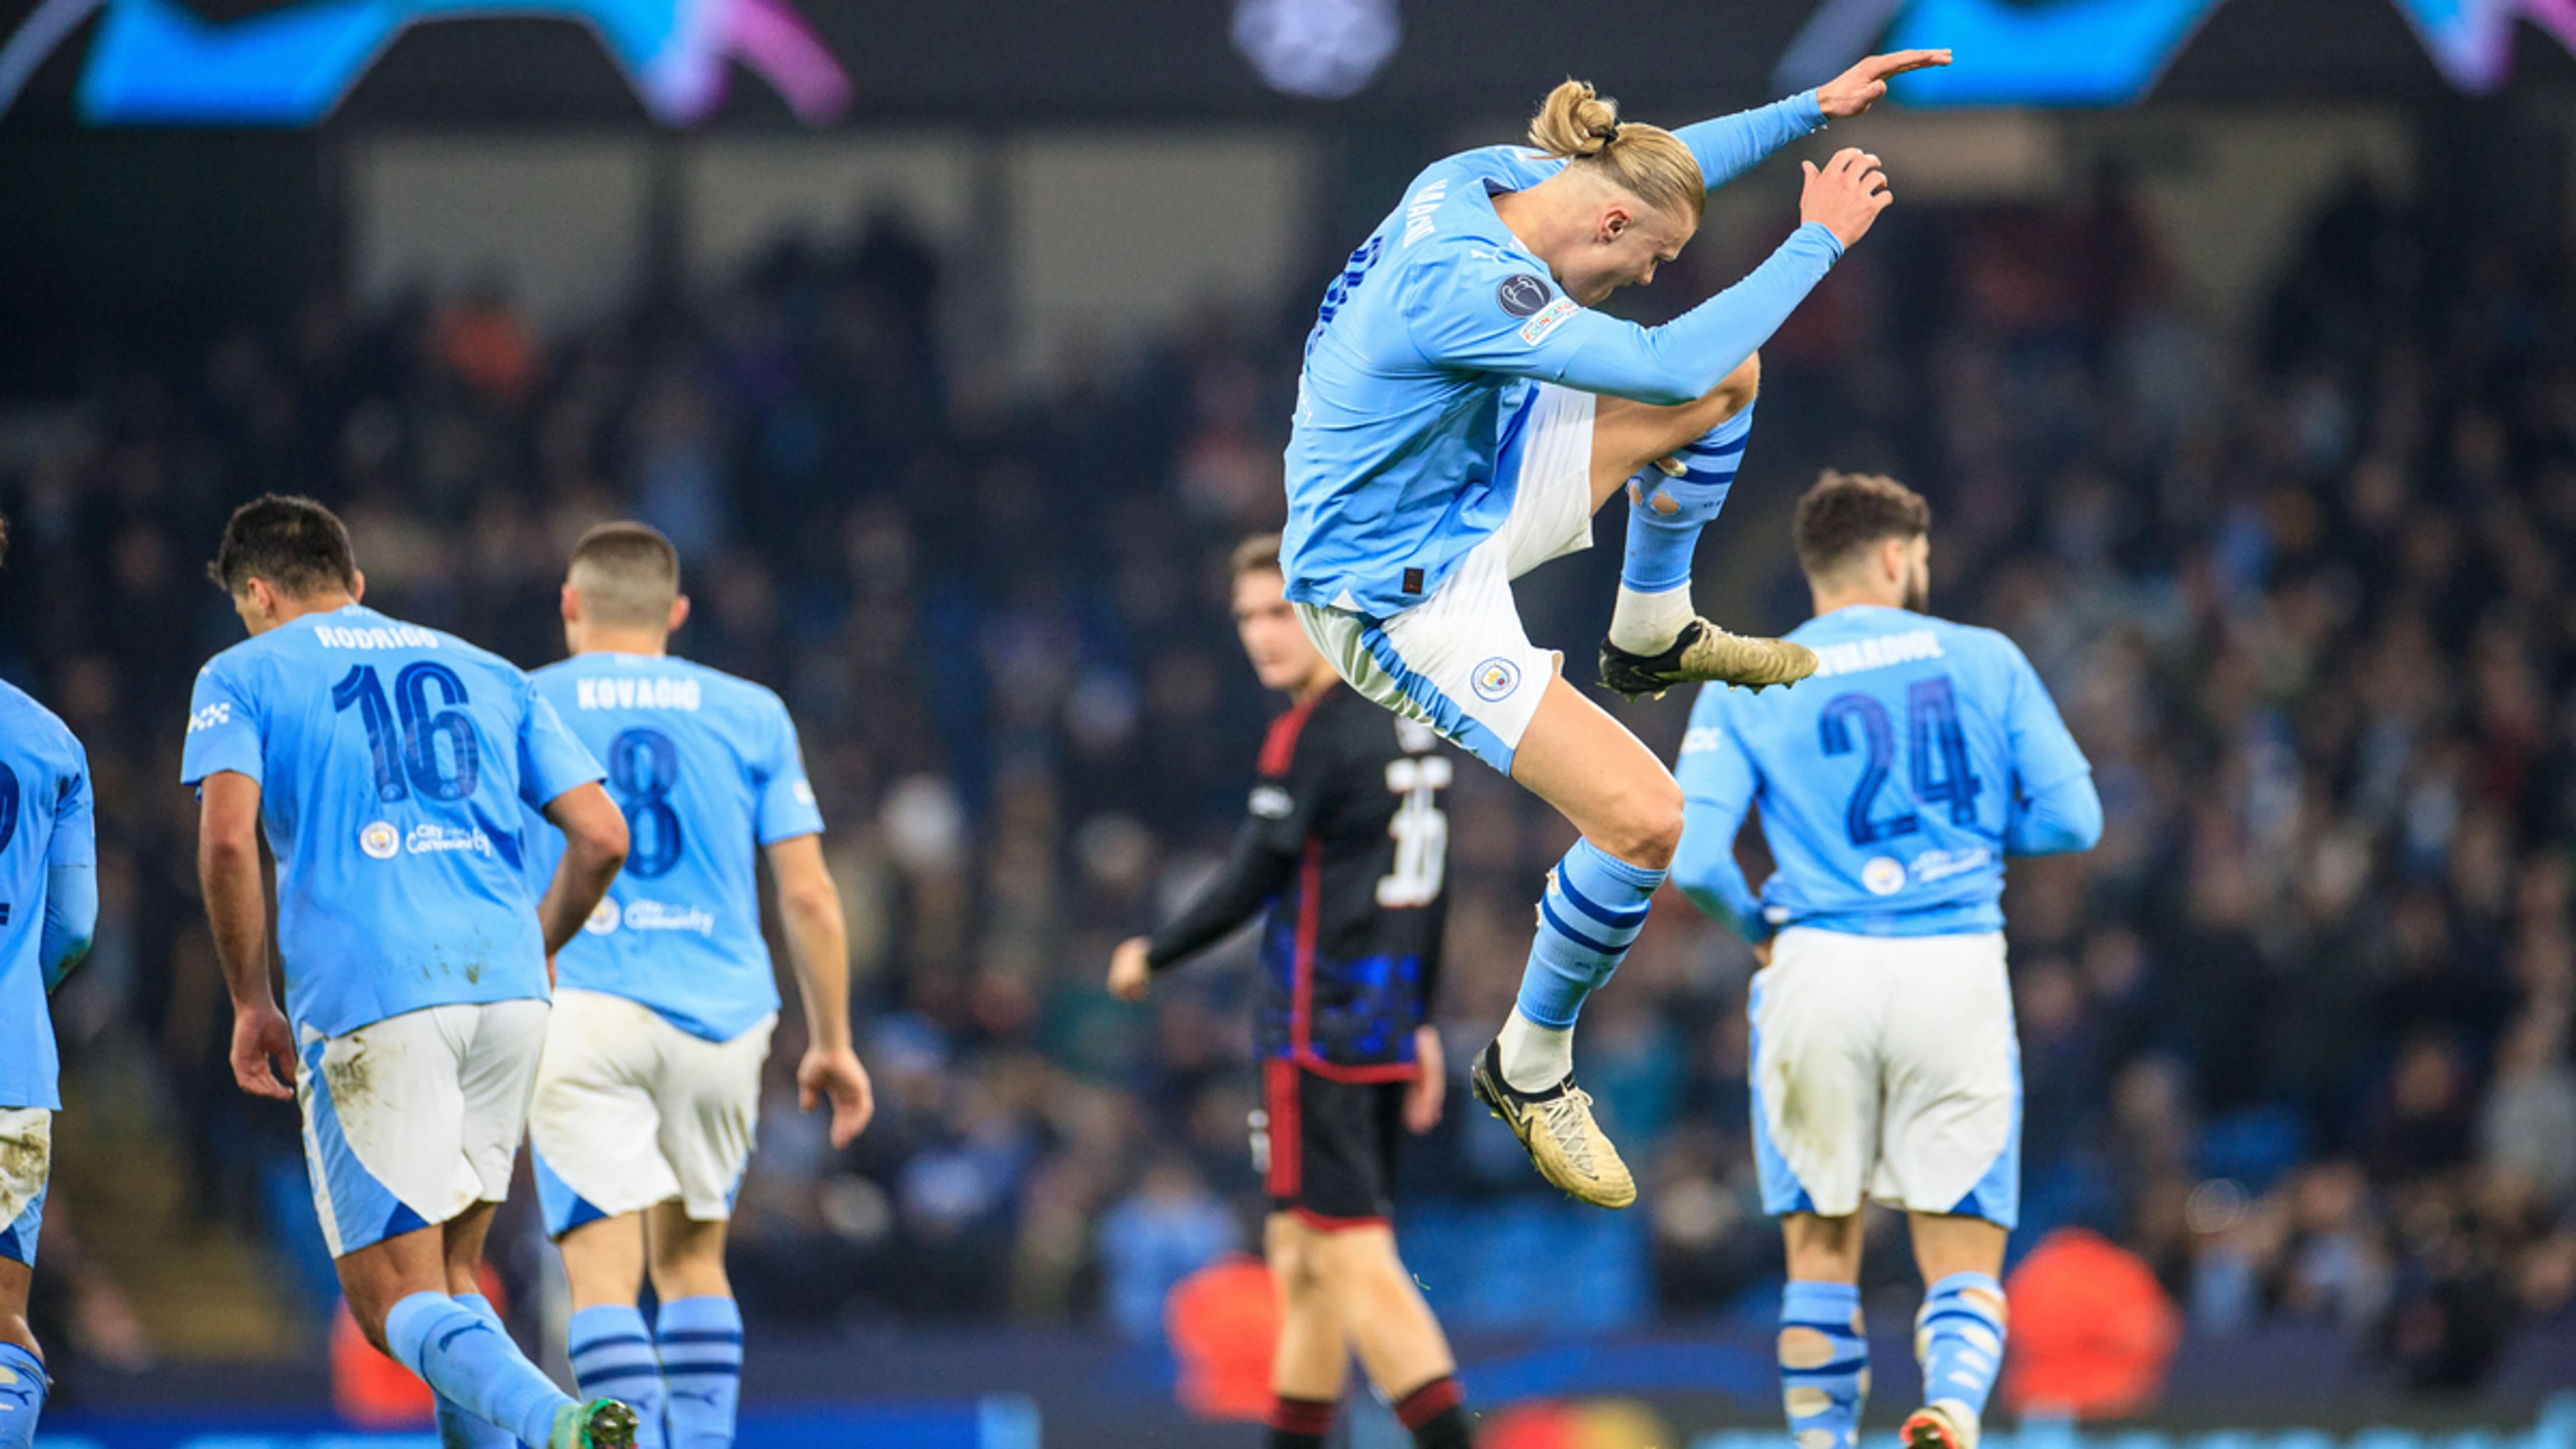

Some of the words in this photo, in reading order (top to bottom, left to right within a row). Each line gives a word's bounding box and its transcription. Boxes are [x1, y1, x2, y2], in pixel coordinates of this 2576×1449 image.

[314, 625, 439, 649] RODRIGO
[331, 661, 478, 802] 16
[608, 729, 682, 879] 8
[1818, 674, 1981, 848] 24
